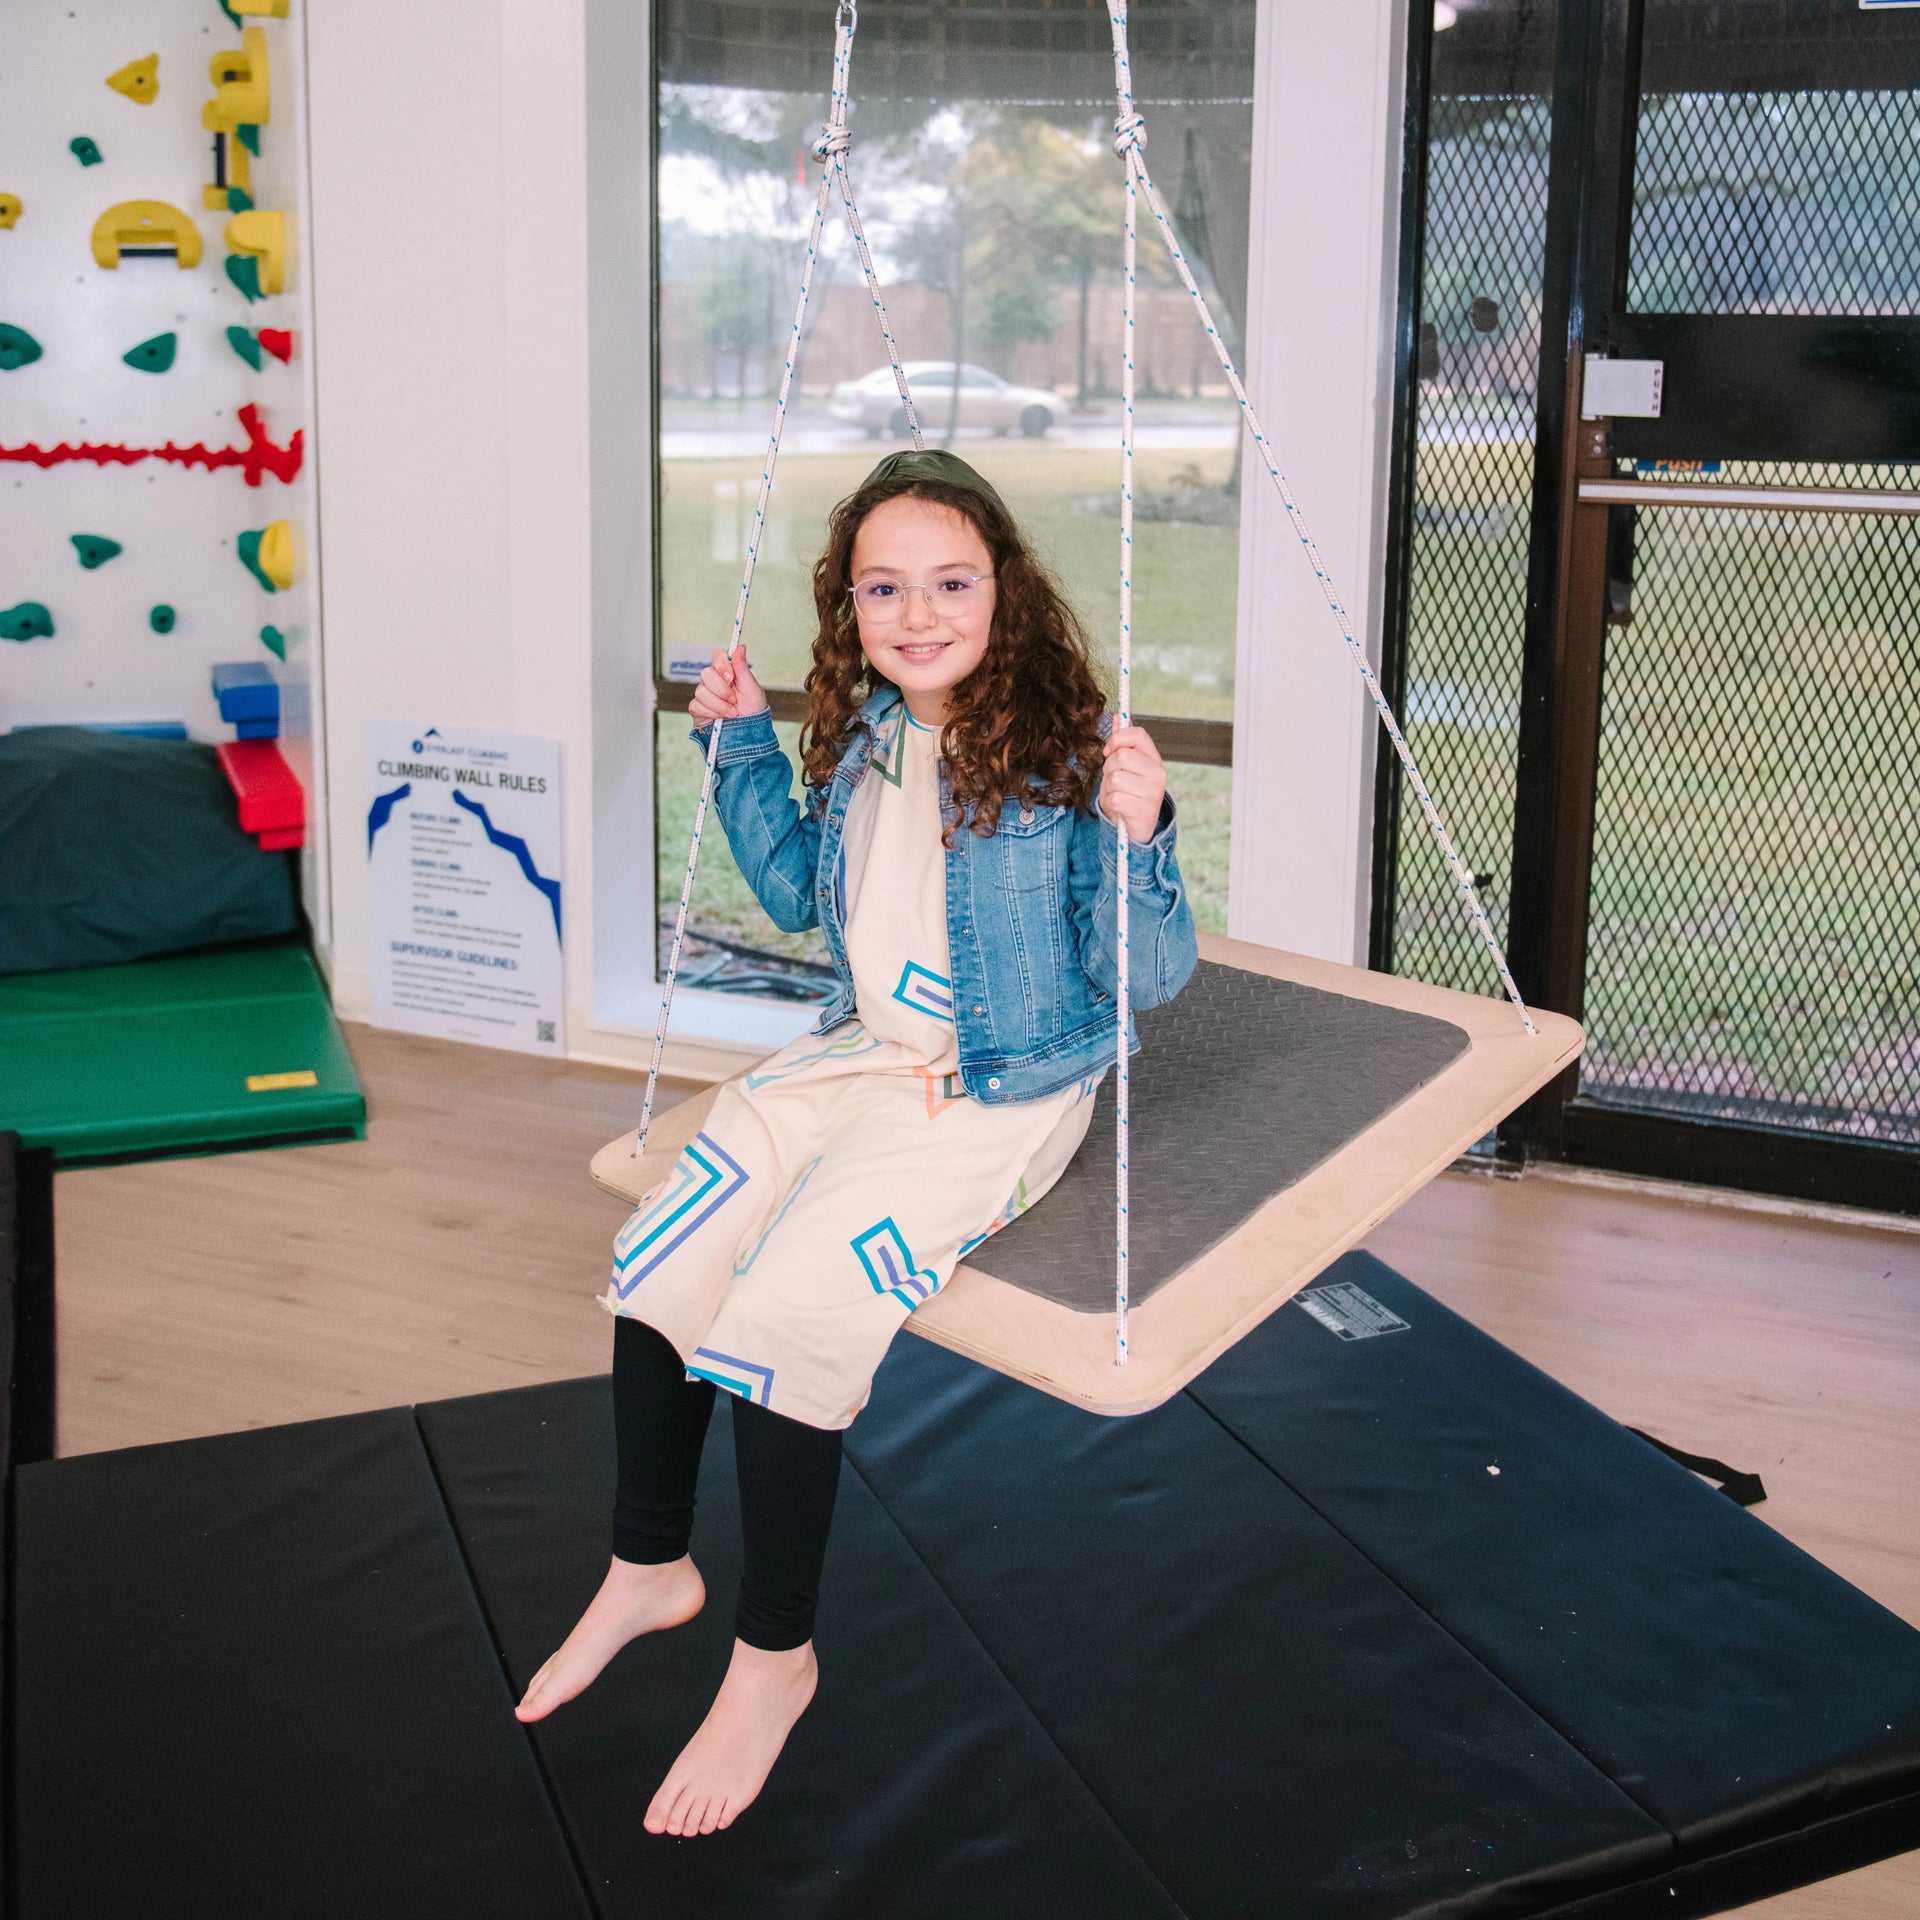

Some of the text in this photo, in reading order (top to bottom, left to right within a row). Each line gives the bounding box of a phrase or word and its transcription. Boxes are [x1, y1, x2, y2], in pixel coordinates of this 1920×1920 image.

[1652, 368, 1661, 411] PUSH
[378, 760, 450, 782] CLIMBING
[454, 767, 494, 787] WALL
[499, 772, 547, 794] RULES
[390, 940, 454, 959] SUPERVISOR
